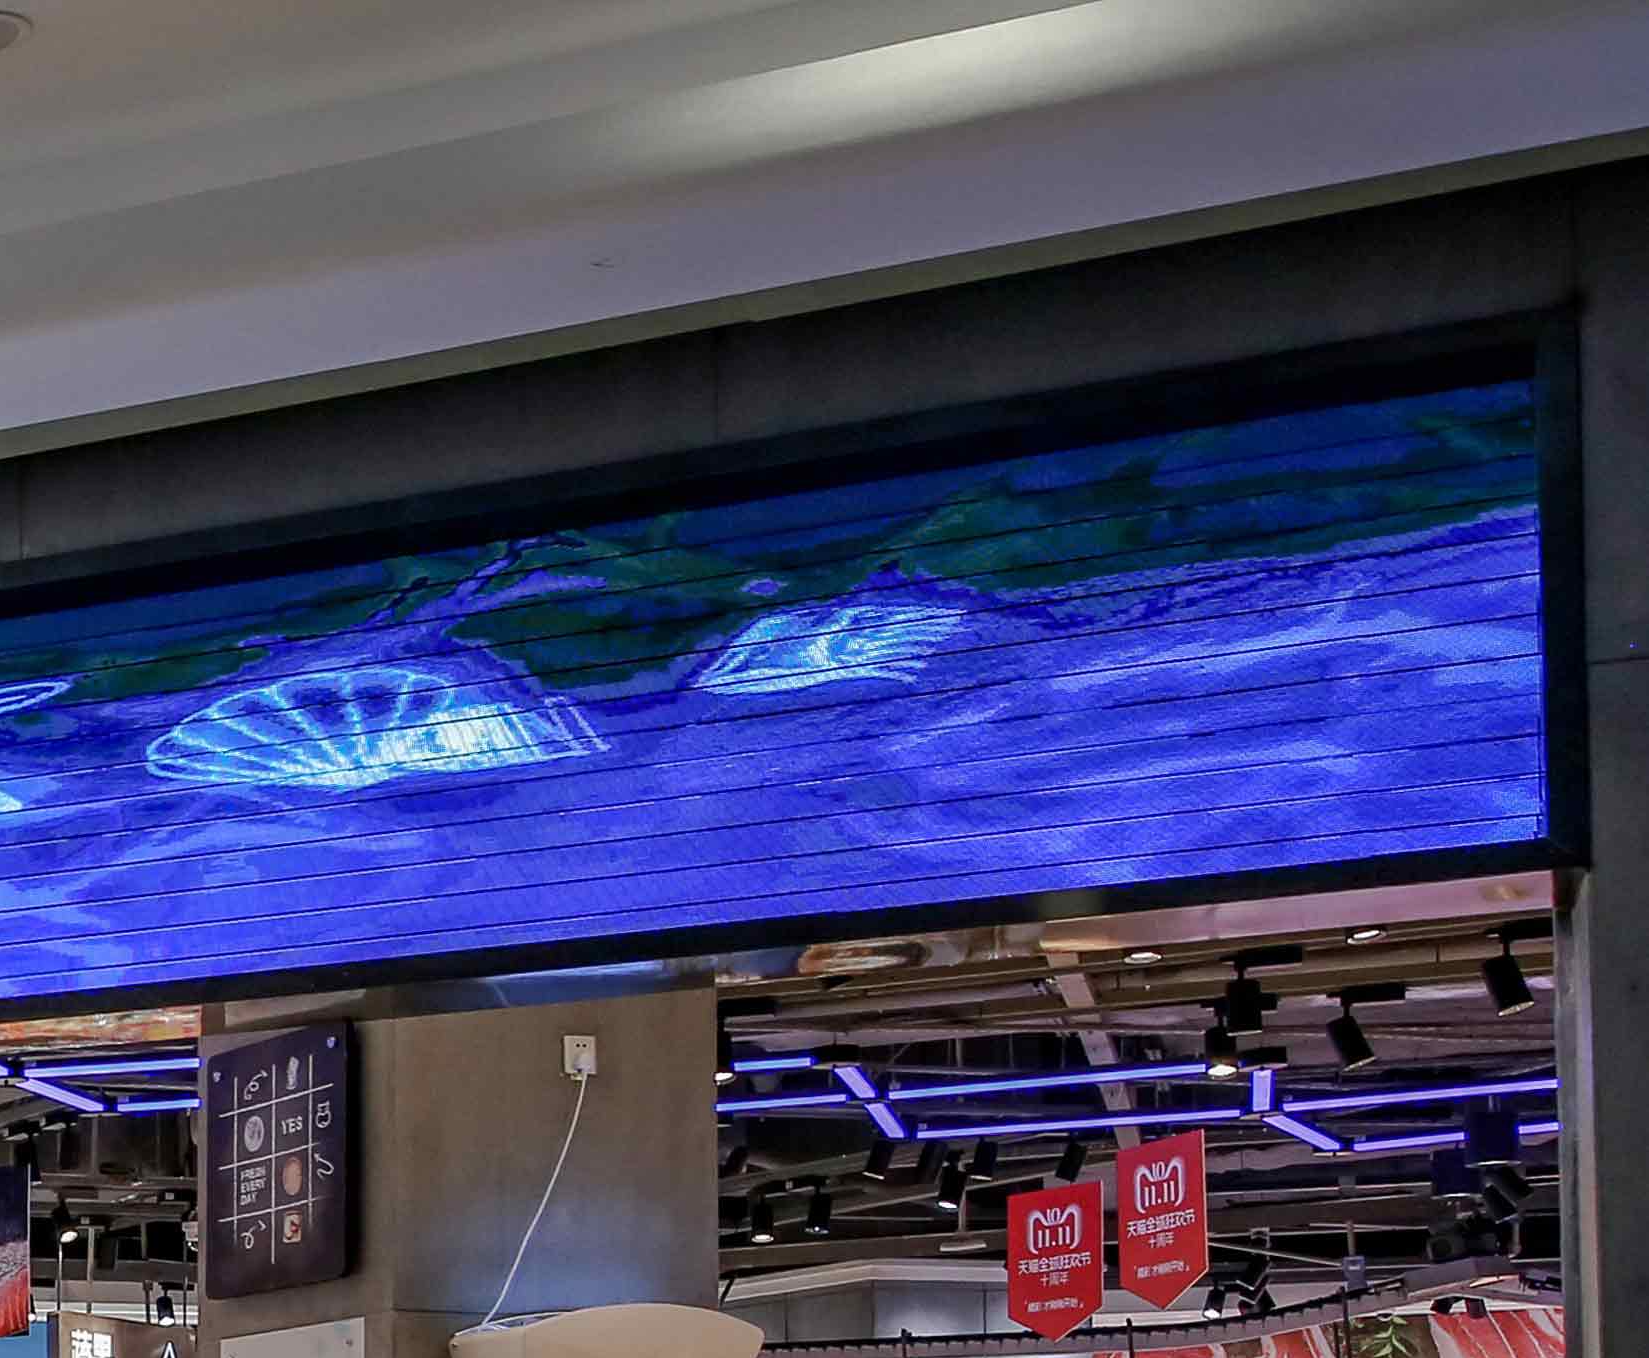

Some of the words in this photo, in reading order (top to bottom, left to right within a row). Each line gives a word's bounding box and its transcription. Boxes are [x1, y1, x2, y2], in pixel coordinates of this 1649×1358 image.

[282, 1116, 302, 1135] YES
[1144, 1181, 1176, 1207] 11.11
[1038, 1226, 1071, 1248] 11.11
